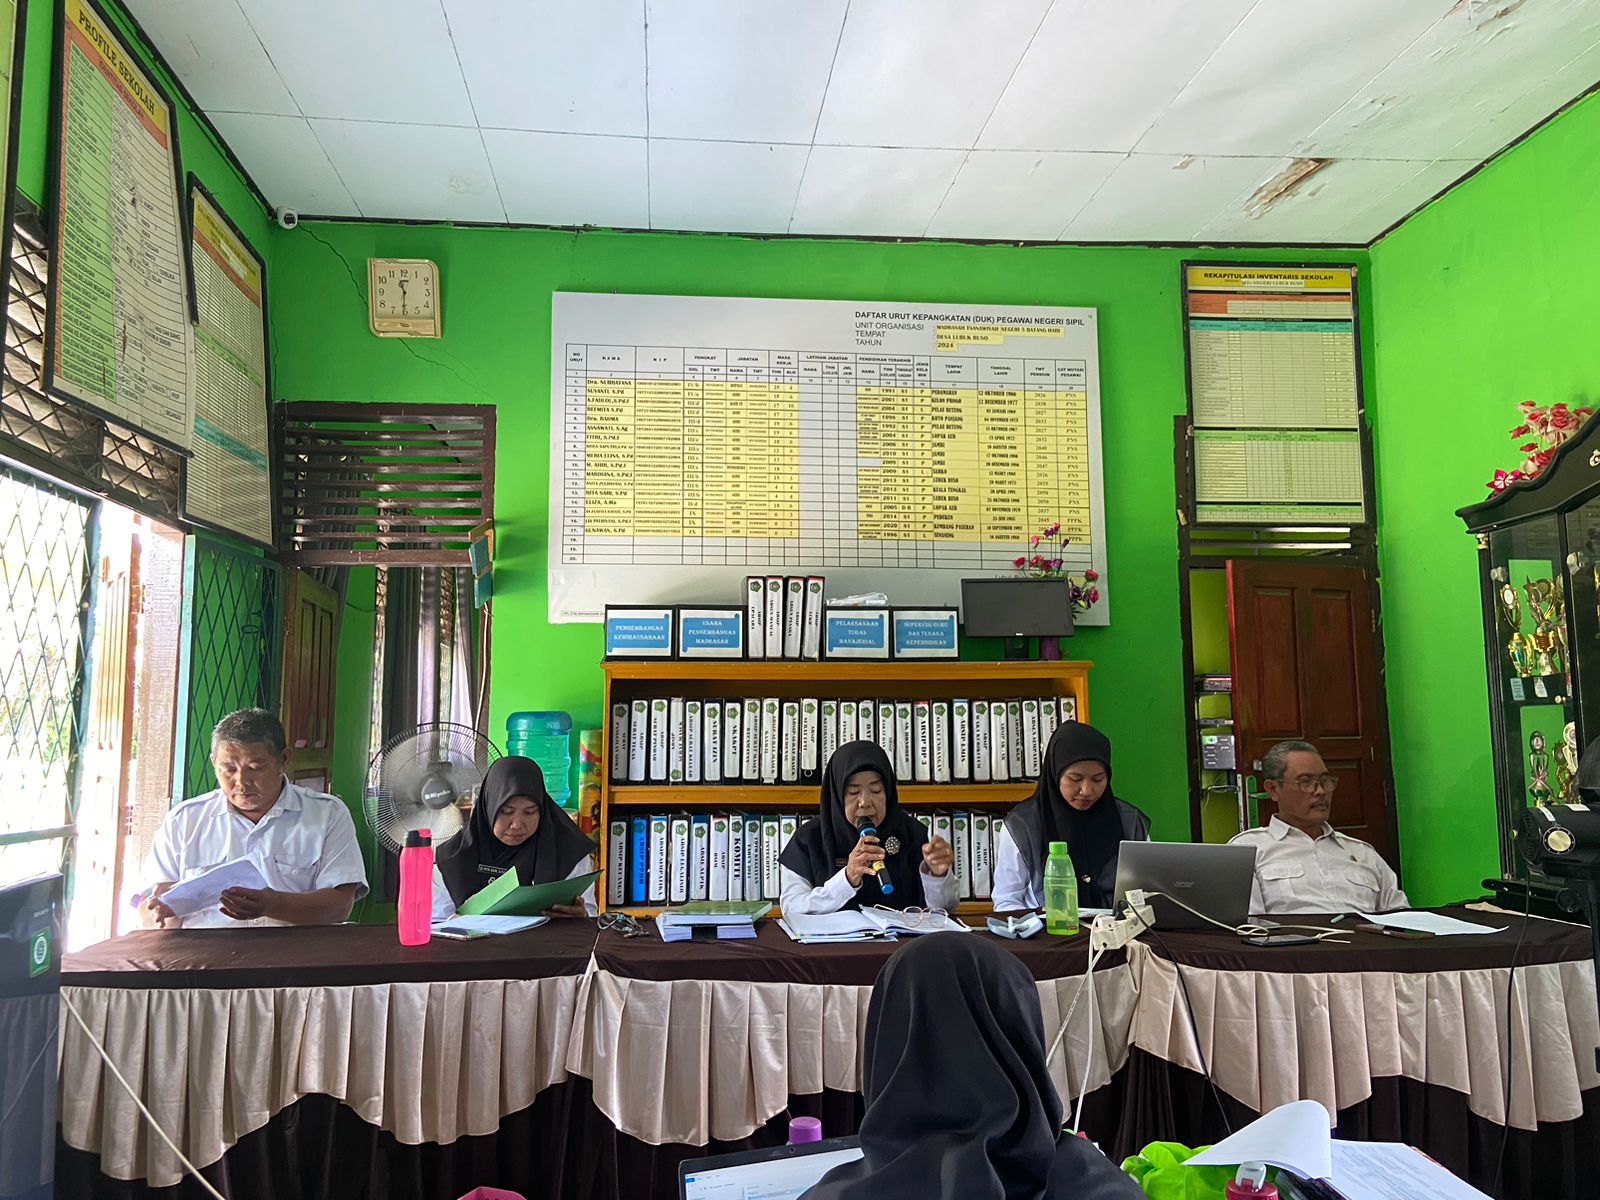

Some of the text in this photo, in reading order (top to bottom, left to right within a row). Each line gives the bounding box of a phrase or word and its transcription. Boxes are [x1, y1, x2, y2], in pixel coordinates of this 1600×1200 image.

[78, 10, 117, 66] PROFILE
[119, 61, 155, 115] SEKOLAH
[424, 277, 429, 285] 2
[912, 314, 971, 322] KEPANGKATAN
